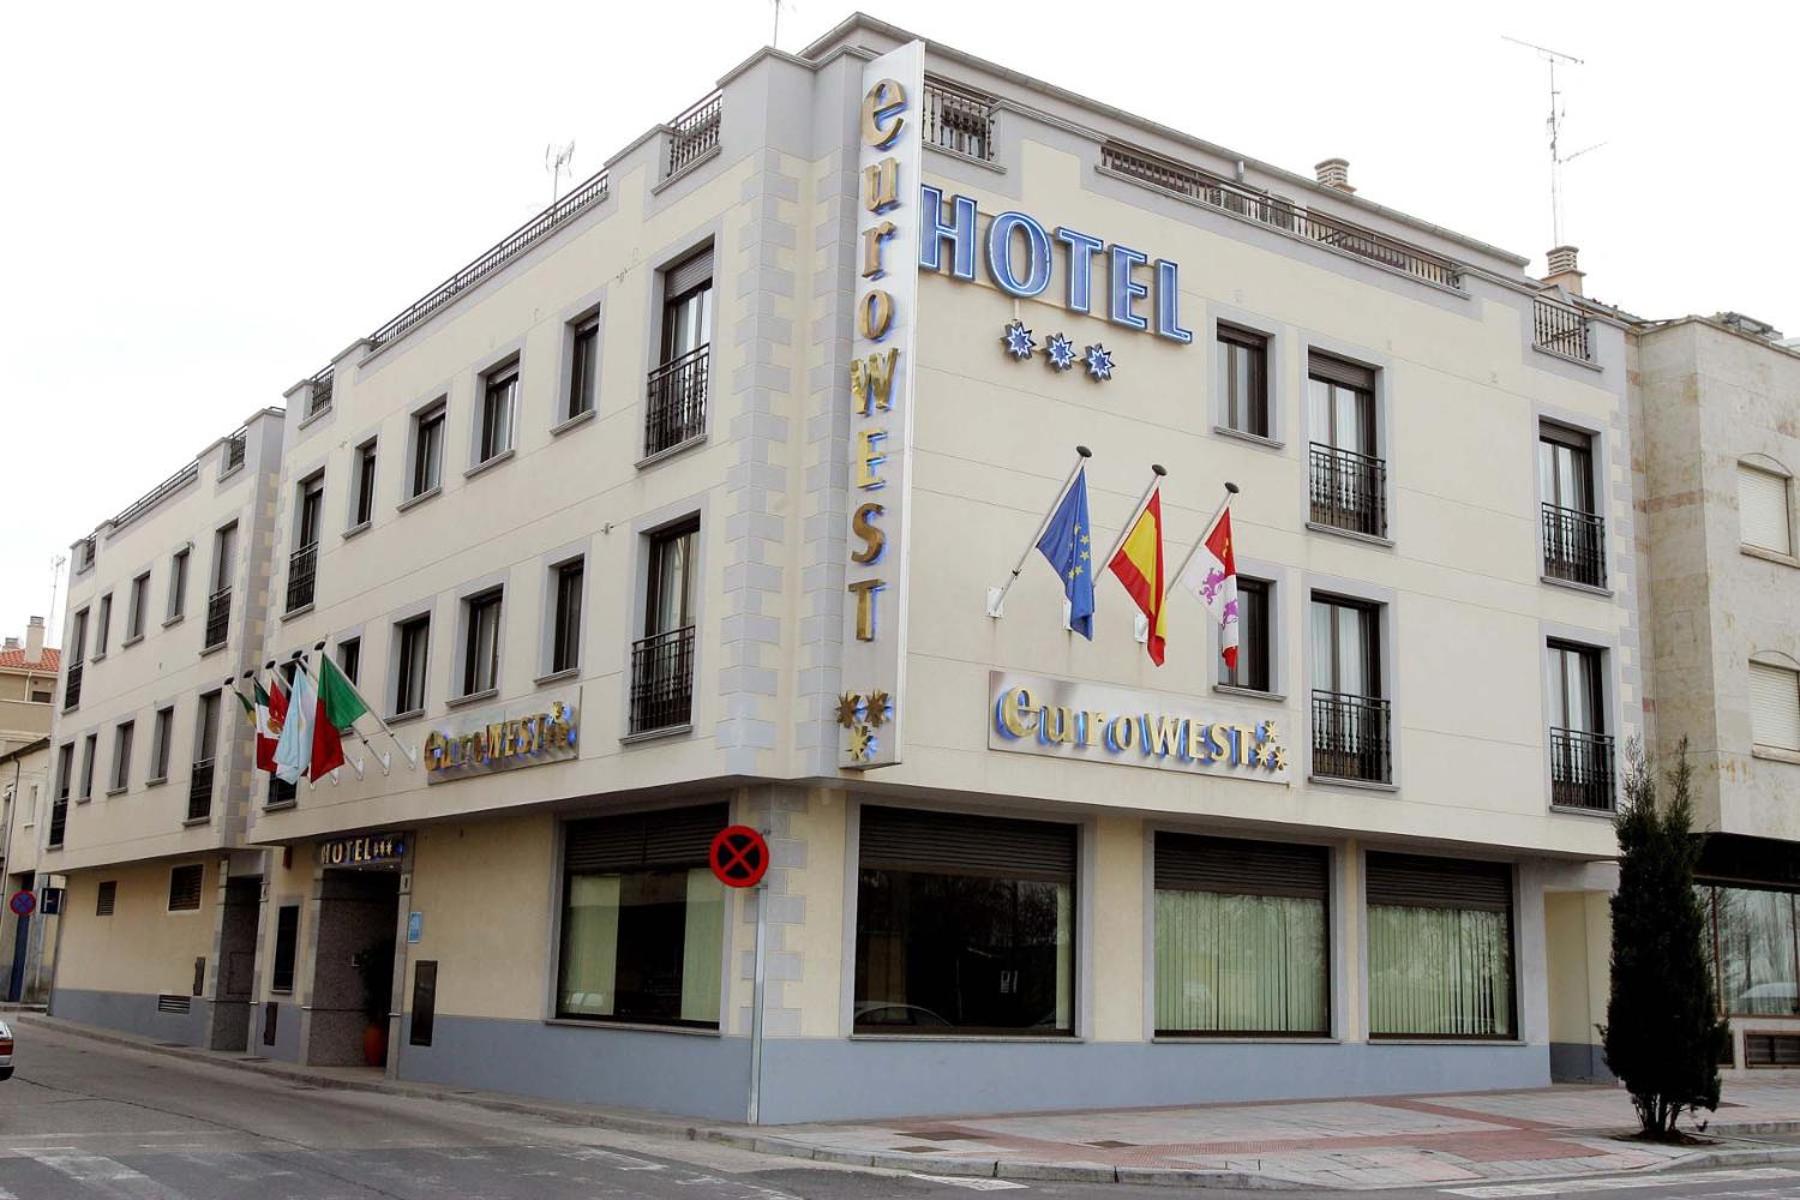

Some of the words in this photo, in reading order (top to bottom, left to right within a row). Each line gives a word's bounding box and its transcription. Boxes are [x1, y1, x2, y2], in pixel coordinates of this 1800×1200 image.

[919, 184, 1193, 344] HOTEL
[849, 78, 907, 642] euroWEST
[997, 685, 1256, 767] euroWEST
[321, 838, 371, 865] HOTEL
